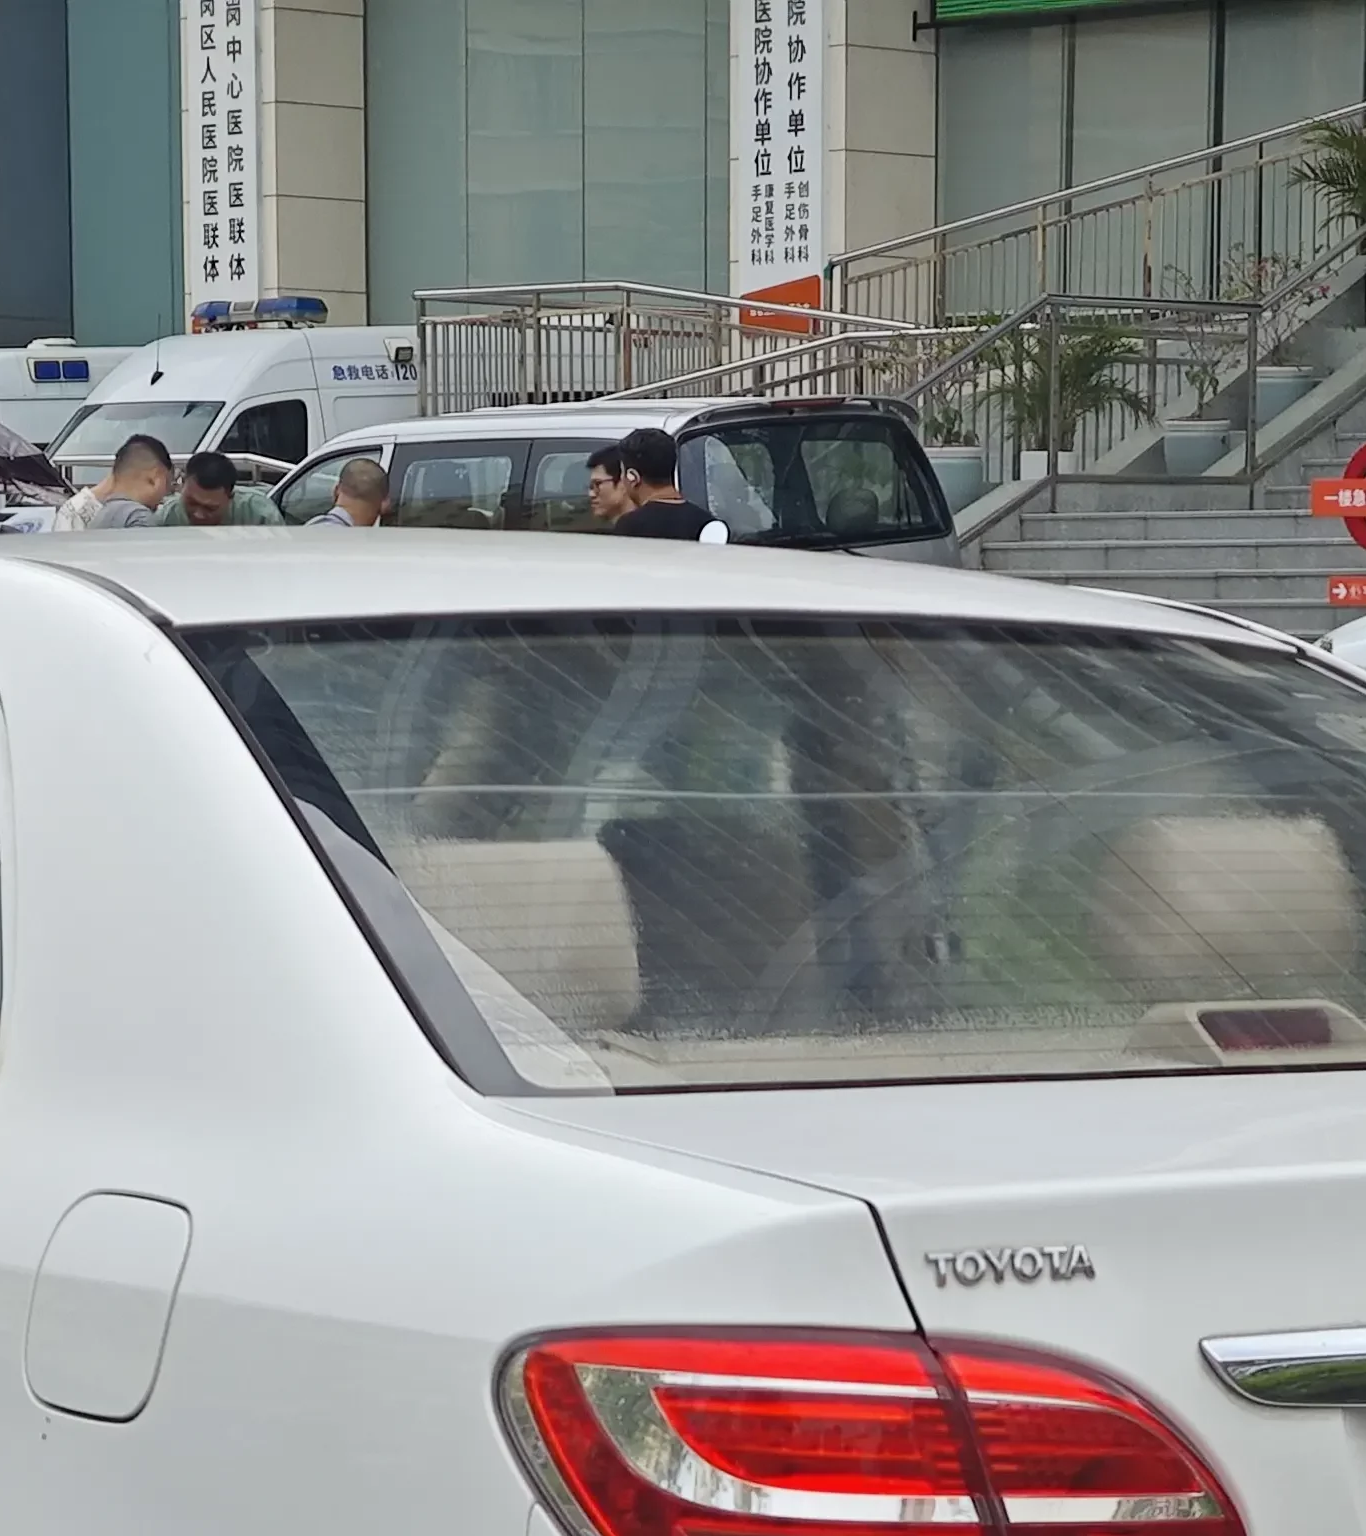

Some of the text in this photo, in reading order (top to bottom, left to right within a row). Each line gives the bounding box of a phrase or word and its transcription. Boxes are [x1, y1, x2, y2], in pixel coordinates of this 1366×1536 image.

[754, 0, 772, 177] 医院协作单位
[787, 0, 806, 174] 院协作单位
[226, 0, 245, 280] 岗中心医院医联体
[751, 184, 762, 265] 手足外科
[764, 184, 774, 264] 康复医学科
[784, 182, 795, 263] 手足外科
[798, 181, 809, 262] 创伤骨科
[926, 1244, 1095, 1287] TOYOTA
